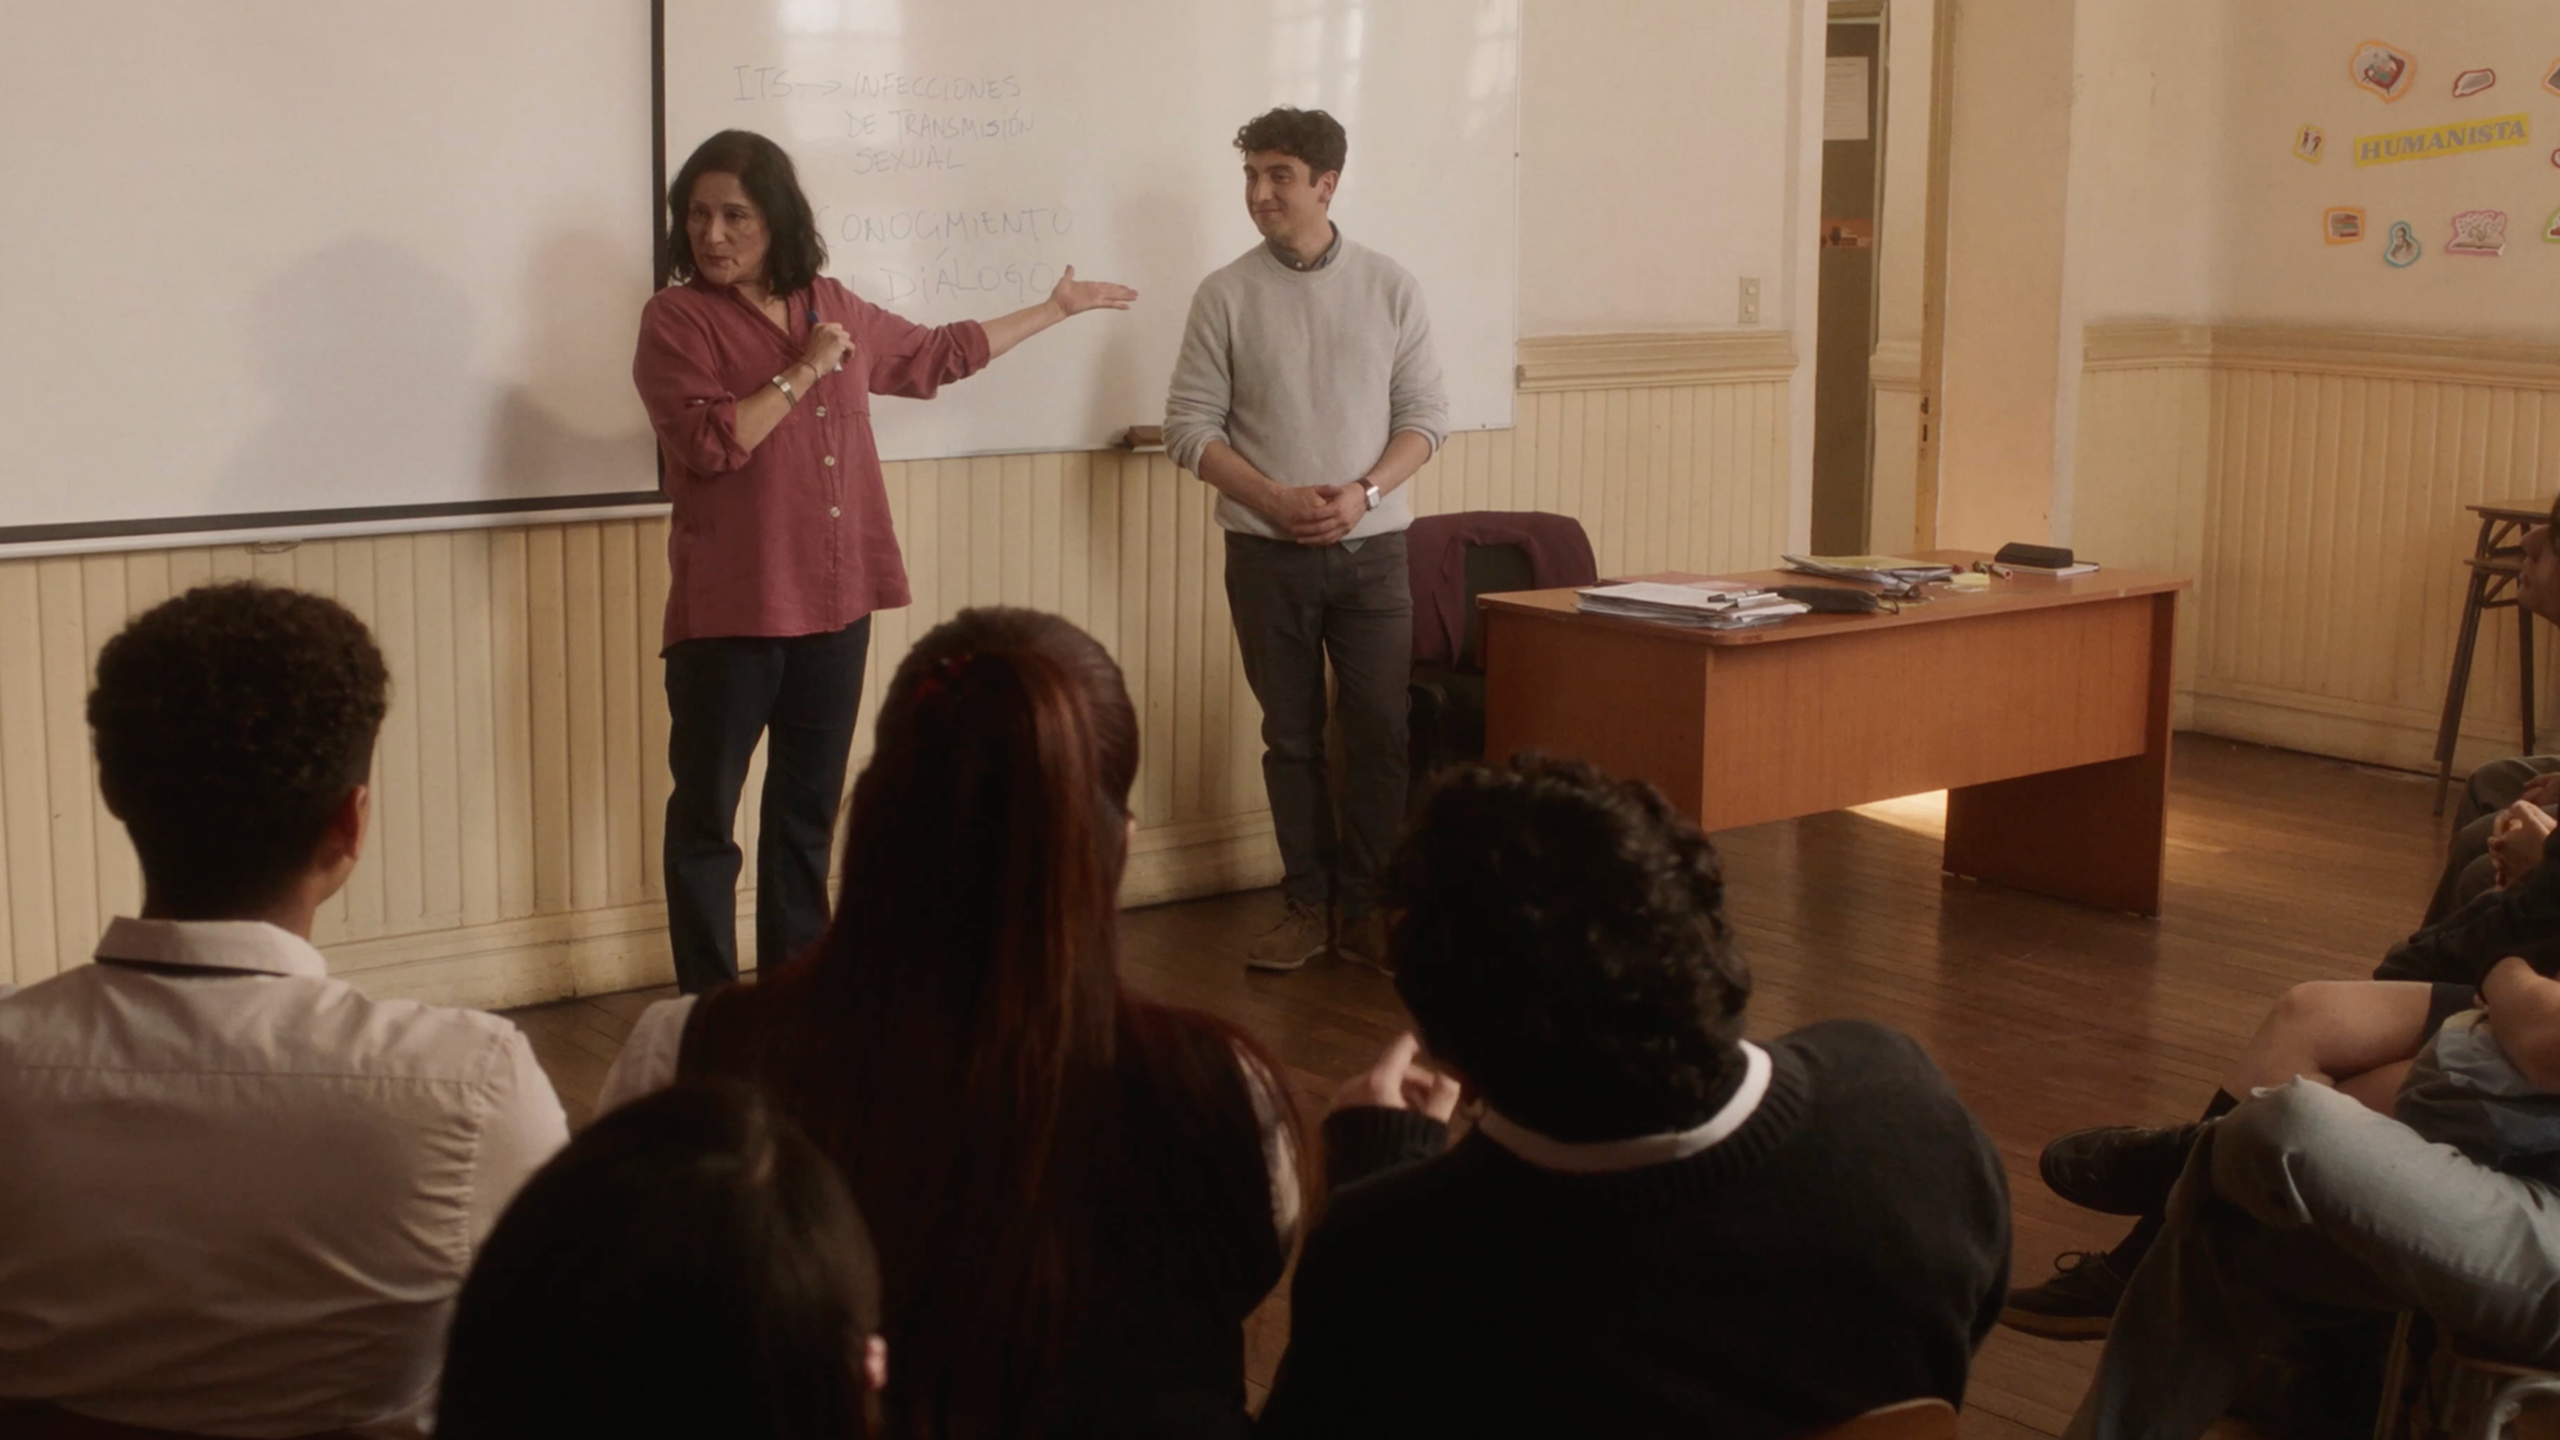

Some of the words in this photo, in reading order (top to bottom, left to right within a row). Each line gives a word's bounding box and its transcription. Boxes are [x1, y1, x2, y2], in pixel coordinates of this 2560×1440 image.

[733, 64, 793, 101] ITS
[853, 71, 1021, 101] INFECCIONES
[845, 110, 877, 138] DE
[888, 108, 1034, 140] TRANSMISIÓN
[2359, 120, 2526, 161] HUMANISTA
[853, 145, 965, 174] SEXUAL
[879, 246, 1055, 304] DIÁLOGO
